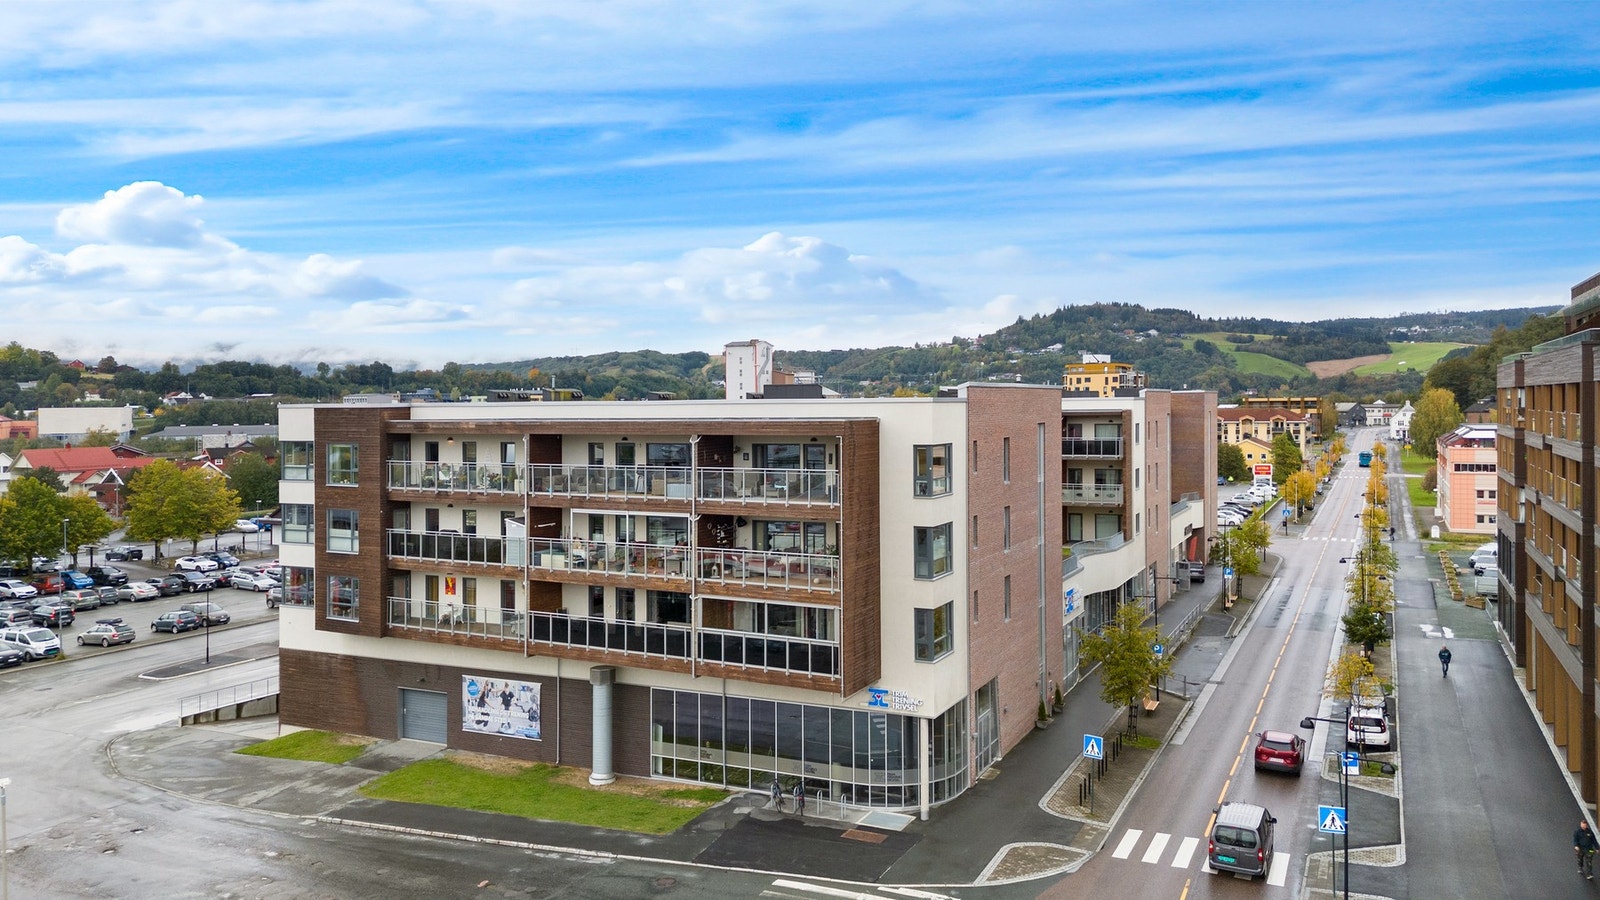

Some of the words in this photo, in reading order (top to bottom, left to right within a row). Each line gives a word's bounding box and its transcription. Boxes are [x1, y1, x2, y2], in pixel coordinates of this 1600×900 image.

[892, 690, 909, 698] TRIM
[892, 697, 923, 706] TRENING
[892, 703, 918, 711] TRIVSEL
